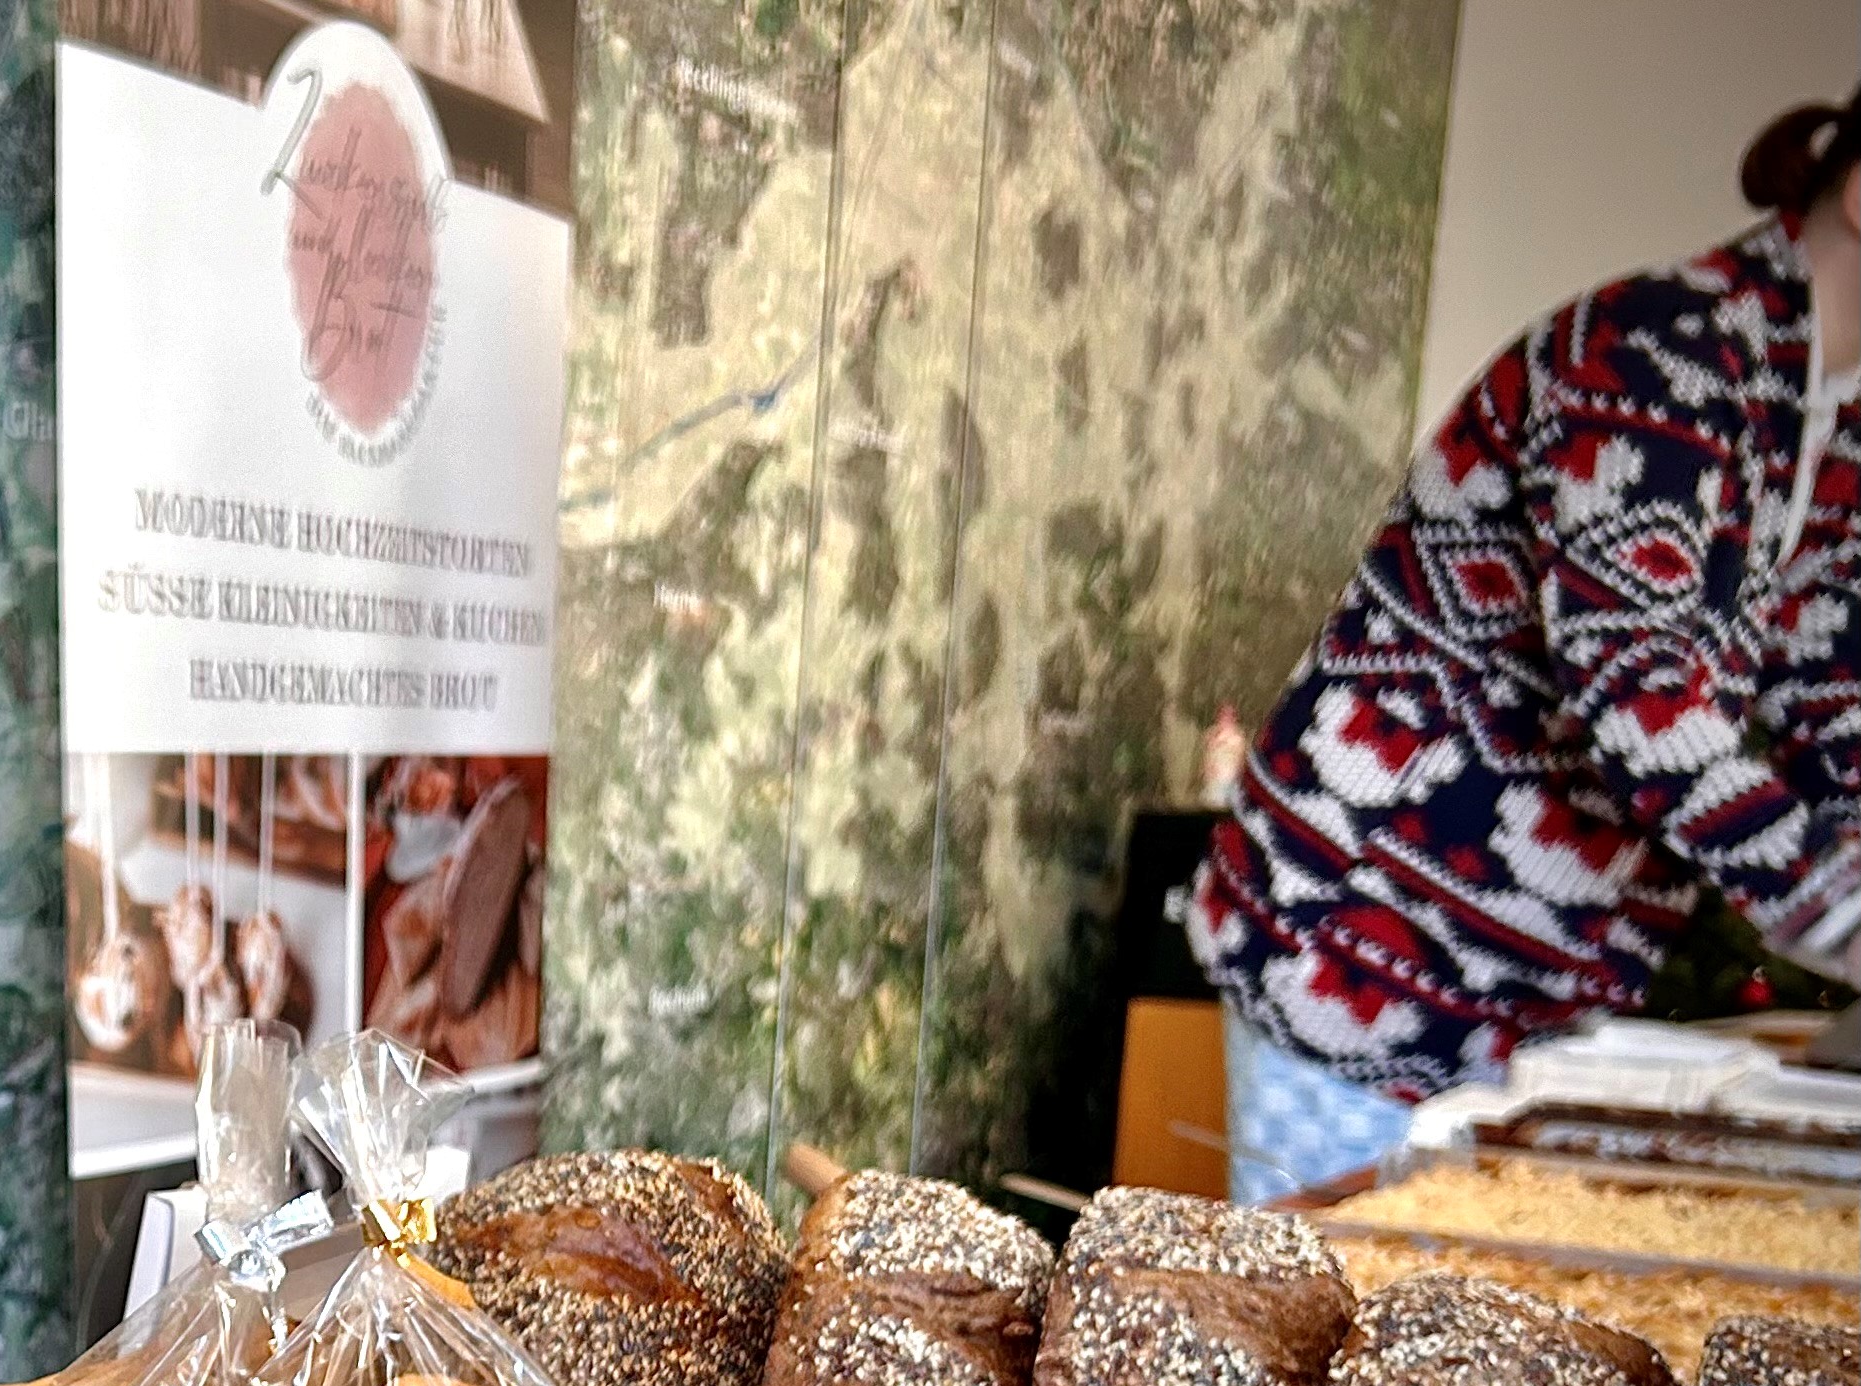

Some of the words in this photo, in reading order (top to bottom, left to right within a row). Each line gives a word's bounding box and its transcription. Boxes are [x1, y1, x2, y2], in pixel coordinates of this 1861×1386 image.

[133, 486, 292, 551] MODERNE
[296, 509, 532, 578] HOCHZEITSTORTEN
[97, 562, 214, 621] SÜSSE
[217, 575, 424, 638] KLEINIGKEITEN
[189, 657, 426, 710] HANDGEMACHTES
[428, 670, 500, 712] BROT
